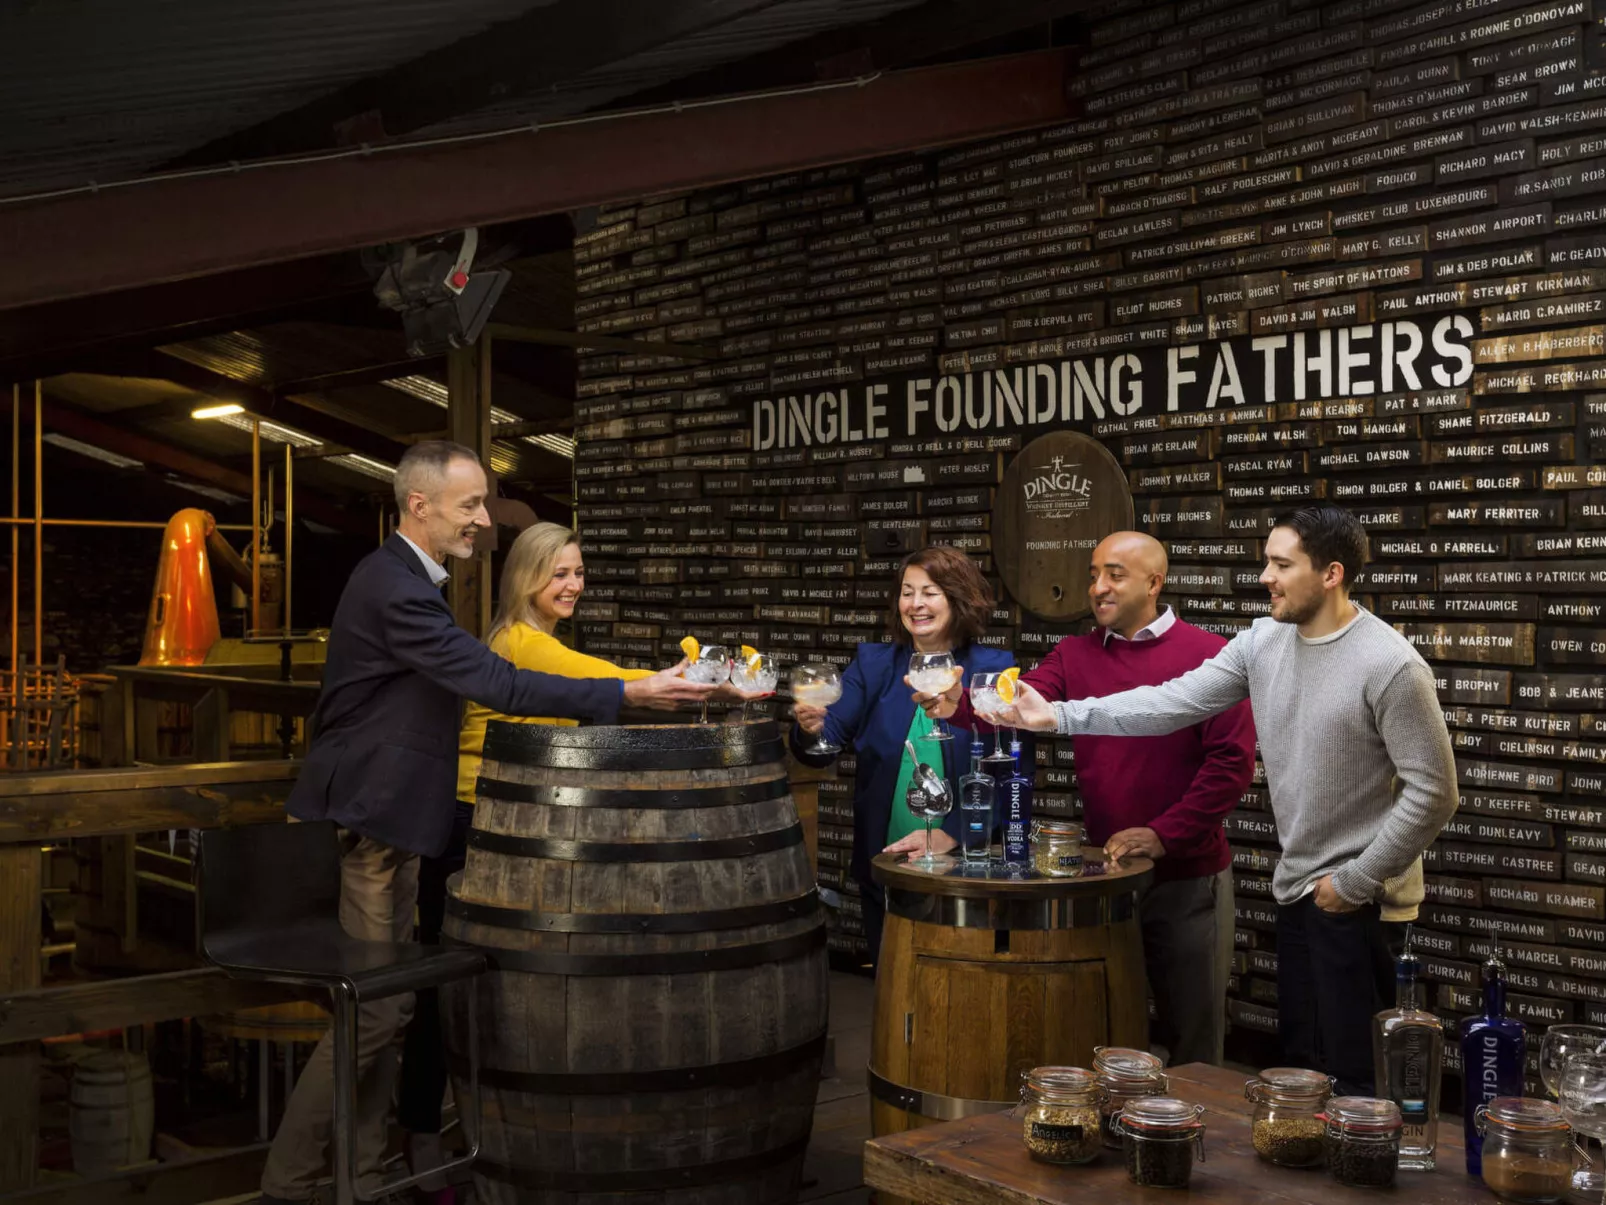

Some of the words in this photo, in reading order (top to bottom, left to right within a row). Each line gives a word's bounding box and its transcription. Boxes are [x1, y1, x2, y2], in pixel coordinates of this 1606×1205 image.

[1419, 34, 1456, 52] CAHILL
[1470, 21, 1510, 40] RONNIE
[1514, 2, 1584, 28] O'DONOVAN
[1376, 75, 1410, 90] PAULA
[1417, 64, 1450, 80] QUINN
[1496, 71, 1528, 88] SEAN
[1535, 58, 1576, 79] BROWN
[1554, 83, 1575, 97] JIM
[1373, 96, 1414, 114] THOMAS
[1416, 83, 1472, 104] O'MAHONY
[1394, 114, 1430, 131] CAROL
[1442, 103, 1475, 120] KEVIN
[1482, 90, 1528, 110] BARDEN
[1482, 121, 1516, 136] DAVID
[1224, 134, 1254, 150] HEALY
[1255, 150, 1290, 165] MARITA
[1300, 140, 1326, 155] ANDY
[1311, 160, 1340, 175] DAVID
[1351, 145, 1407, 167] GERALDINE
[1413, 130, 1464, 152] BRENNAN
[1541, 146, 1572, 160] HOLY
[1086, 164, 1110, 175] DAVID
[1114, 155, 1154, 169] SPILLANE
[1439, 157, 1486, 175] RICHARD
[1493, 149, 1526, 164] MACY
[1204, 184, 1228, 196] RALF
[1232, 172, 1292, 190] PODLESCHNY
[1264, 198, 1286, 208] ANNE
[1299, 188, 1323, 201] JOHN
[1329, 182, 1360, 195] HAIGH
[1335, 210, 1376, 226] WHISKEY
[1382, 203, 1409, 217] CLUB
[1415, 188, 1488, 212] LUXEMBOURG
[1270, 226, 1287, 236] JIM
[1292, 220, 1324, 233] LYNCH
[1436, 223, 1486, 242] SHANNON
[1220, 231, 1256, 245] GREENE
[1342, 241, 1370, 255] MARY
[1388, 234, 1422, 248] KELLY
[1436, 264, 1454, 276] JIM
[1456, 262, 1464, 274] &
[1467, 258, 1488, 272] DEB
[1491, 252, 1534, 268] POLIAK
[1293, 281, 1310, 292] THE
[1313, 275, 1344, 289] SPIRIT
[1347, 273, 1360, 284] OF
[1362, 266, 1410, 282] HATTONS
[1206, 292, 1243, 304] PATRICK
[1248, 284, 1280, 298] RIGNEY
[1383, 298, 1408, 310] PAUL
[1414, 290, 1465, 306] ANTHONY
[1472, 282, 1528, 299] STEWART
[1536, 275, 1590, 292] KIRKMAN
[1116, 304, 1144, 316] ELLIOT
[1148, 299, 1182, 312] HUGHES
[1260, 314, 1288, 326] DAVID
[1300, 310, 1316, 322] JIM
[1322, 304, 1356, 318] WALSH
[1496, 310, 1530, 324] MARIO
[1140, 329, 1168, 340] WHITE
[1175, 323, 1204, 335] SHAUN
[1208, 319, 1238, 332] HAYES
[754, 384, 890, 452] DINGLE
[907, 353, 1143, 436] FOUNDING
[1167, 314, 1474, 412] FATHERS
[1487, 375, 1536, 388] MICHAEL
[1300, 408, 1320, 418] ANN
[1325, 403, 1364, 416] KEARNS
[1385, 399, 1405, 411] PAT
[1412, 398, 1419, 408] &
[1426, 394, 1458, 407] MARK
[1232, 408, 1264, 421] ANNIKA
[1438, 416, 1472, 430] SHANE
[1479, 412, 1551, 426] FITZGERALD
[1134, 418, 1158, 430] FRIEL
[1337, 424, 1357, 436] TOM
[1363, 422, 1406, 434] MANGAN
[1226, 432, 1268, 443] BRENDAN
[1273, 430, 1305, 441] WALSH
[1124, 444, 1148, 456] BRIAN
[1447, 445, 1495, 457] MAURICE
[1502, 442, 1550, 455] COLLINS
[1228, 460, 1263, 472] PASCAL
[1266, 458, 1292, 470] RYAN
[1320, 454, 1360, 466] MICHAEL
[1366, 450, 1410, 460] DAWSON
[1139, 475, 1171, 486] JOHNNY
[1175, 472, 1210, 484] WALKER
[1336, 484, 1364, 495] SIMON
[1370, 482, 1408, 494] BOLGER
[1415, 482, 1422, 492] &
[1429, 480, 1468, 492] DANIEL
[1476, 477, 1520, 489] BOLGER
[1547, 472, 1578, 484] PAUL
[1024, 473, 1092, 500] DINGLE
[1229, 486, 1264, 497] THOMAS
[1270, 484, 1310, 495] MICHELS
[1142, 512, 1172, 524] OLIVER
[1177, 512, 1212, 522] HUGHES
[1359, 513, 1400, 524] CLARKE
[1448, 508, 1478, 520] MARY
[1485, 508, 1540, 519] FERRITER
[1228, 518, 1258, 528] ALLAN
[1026, 540, 1061, 550] FOUNDING
[1064, 539, 1098, 549] FATHERS
[1381, 542, 1424, 554] MICHAEL
[1444, 542, 1496, 553] FARRELL
[1537, 537, 1572, 551] BRIAN
[1372, 574, 1418, 584] GRIFFITH
[1444, 573, 1472, 584] MARK
[1476, 572, 1522, 584] KEATING
[1525, 572, 1532, 582] &
[1536, 571, 1586, 582] PATRICK
[1188, 600, 1216, 610] FRANK
[1392, 600, 1436, 611] PAULINE
[1445, 600, 1518, 612] FITZMAURICE
[1548, 604, 1601, 616] ANTHONY
[1459, 635, 1514, 648] MARSTON
[1550, 640, 1582, 652] OWEN
[1455, 680, 1500, 692] BROPHY
[1519, 686, 1542, 697] BOB
[1481, 714, 1518, 727] PETER
[1524, 718, 1571, 731] KUTNER
[1500, 742, 1554, 755] CIELINSKI
[1466, 767, 1520, 782] ADRIENNE
[1528, 774, 1554, 786] BIRD
[1571, 777, 1602, 790] JOHN
[1010, 783, 1020, 820] DINGLE
[1545, 808, 1602, 823] STEWART
[1479, 825, 1542, 841] DUNLEAVY
[1446, 852, 1495, 866] STEPHEN
[1502, 856, 1554, 872] CASTREE
[1489, 886, 1538, 902] RICHARD
[1546, 893, 1596, 908] KRAMER
[1432, 912, 1462, 926] LARS
[1468, 917, 1545, 936] ZIMMERMANN
[1568, 926, 1605, 942] DAVID
[1427, 963, 1472, 981] CURRAN
[1452, 992, 1472, 1006] THE
[1518, 1003, 1564, 1020] FAMILY
[1482, 1036, 1498, 1100] DINGLE
[1401, 1126, 1424, 1136] GIN
